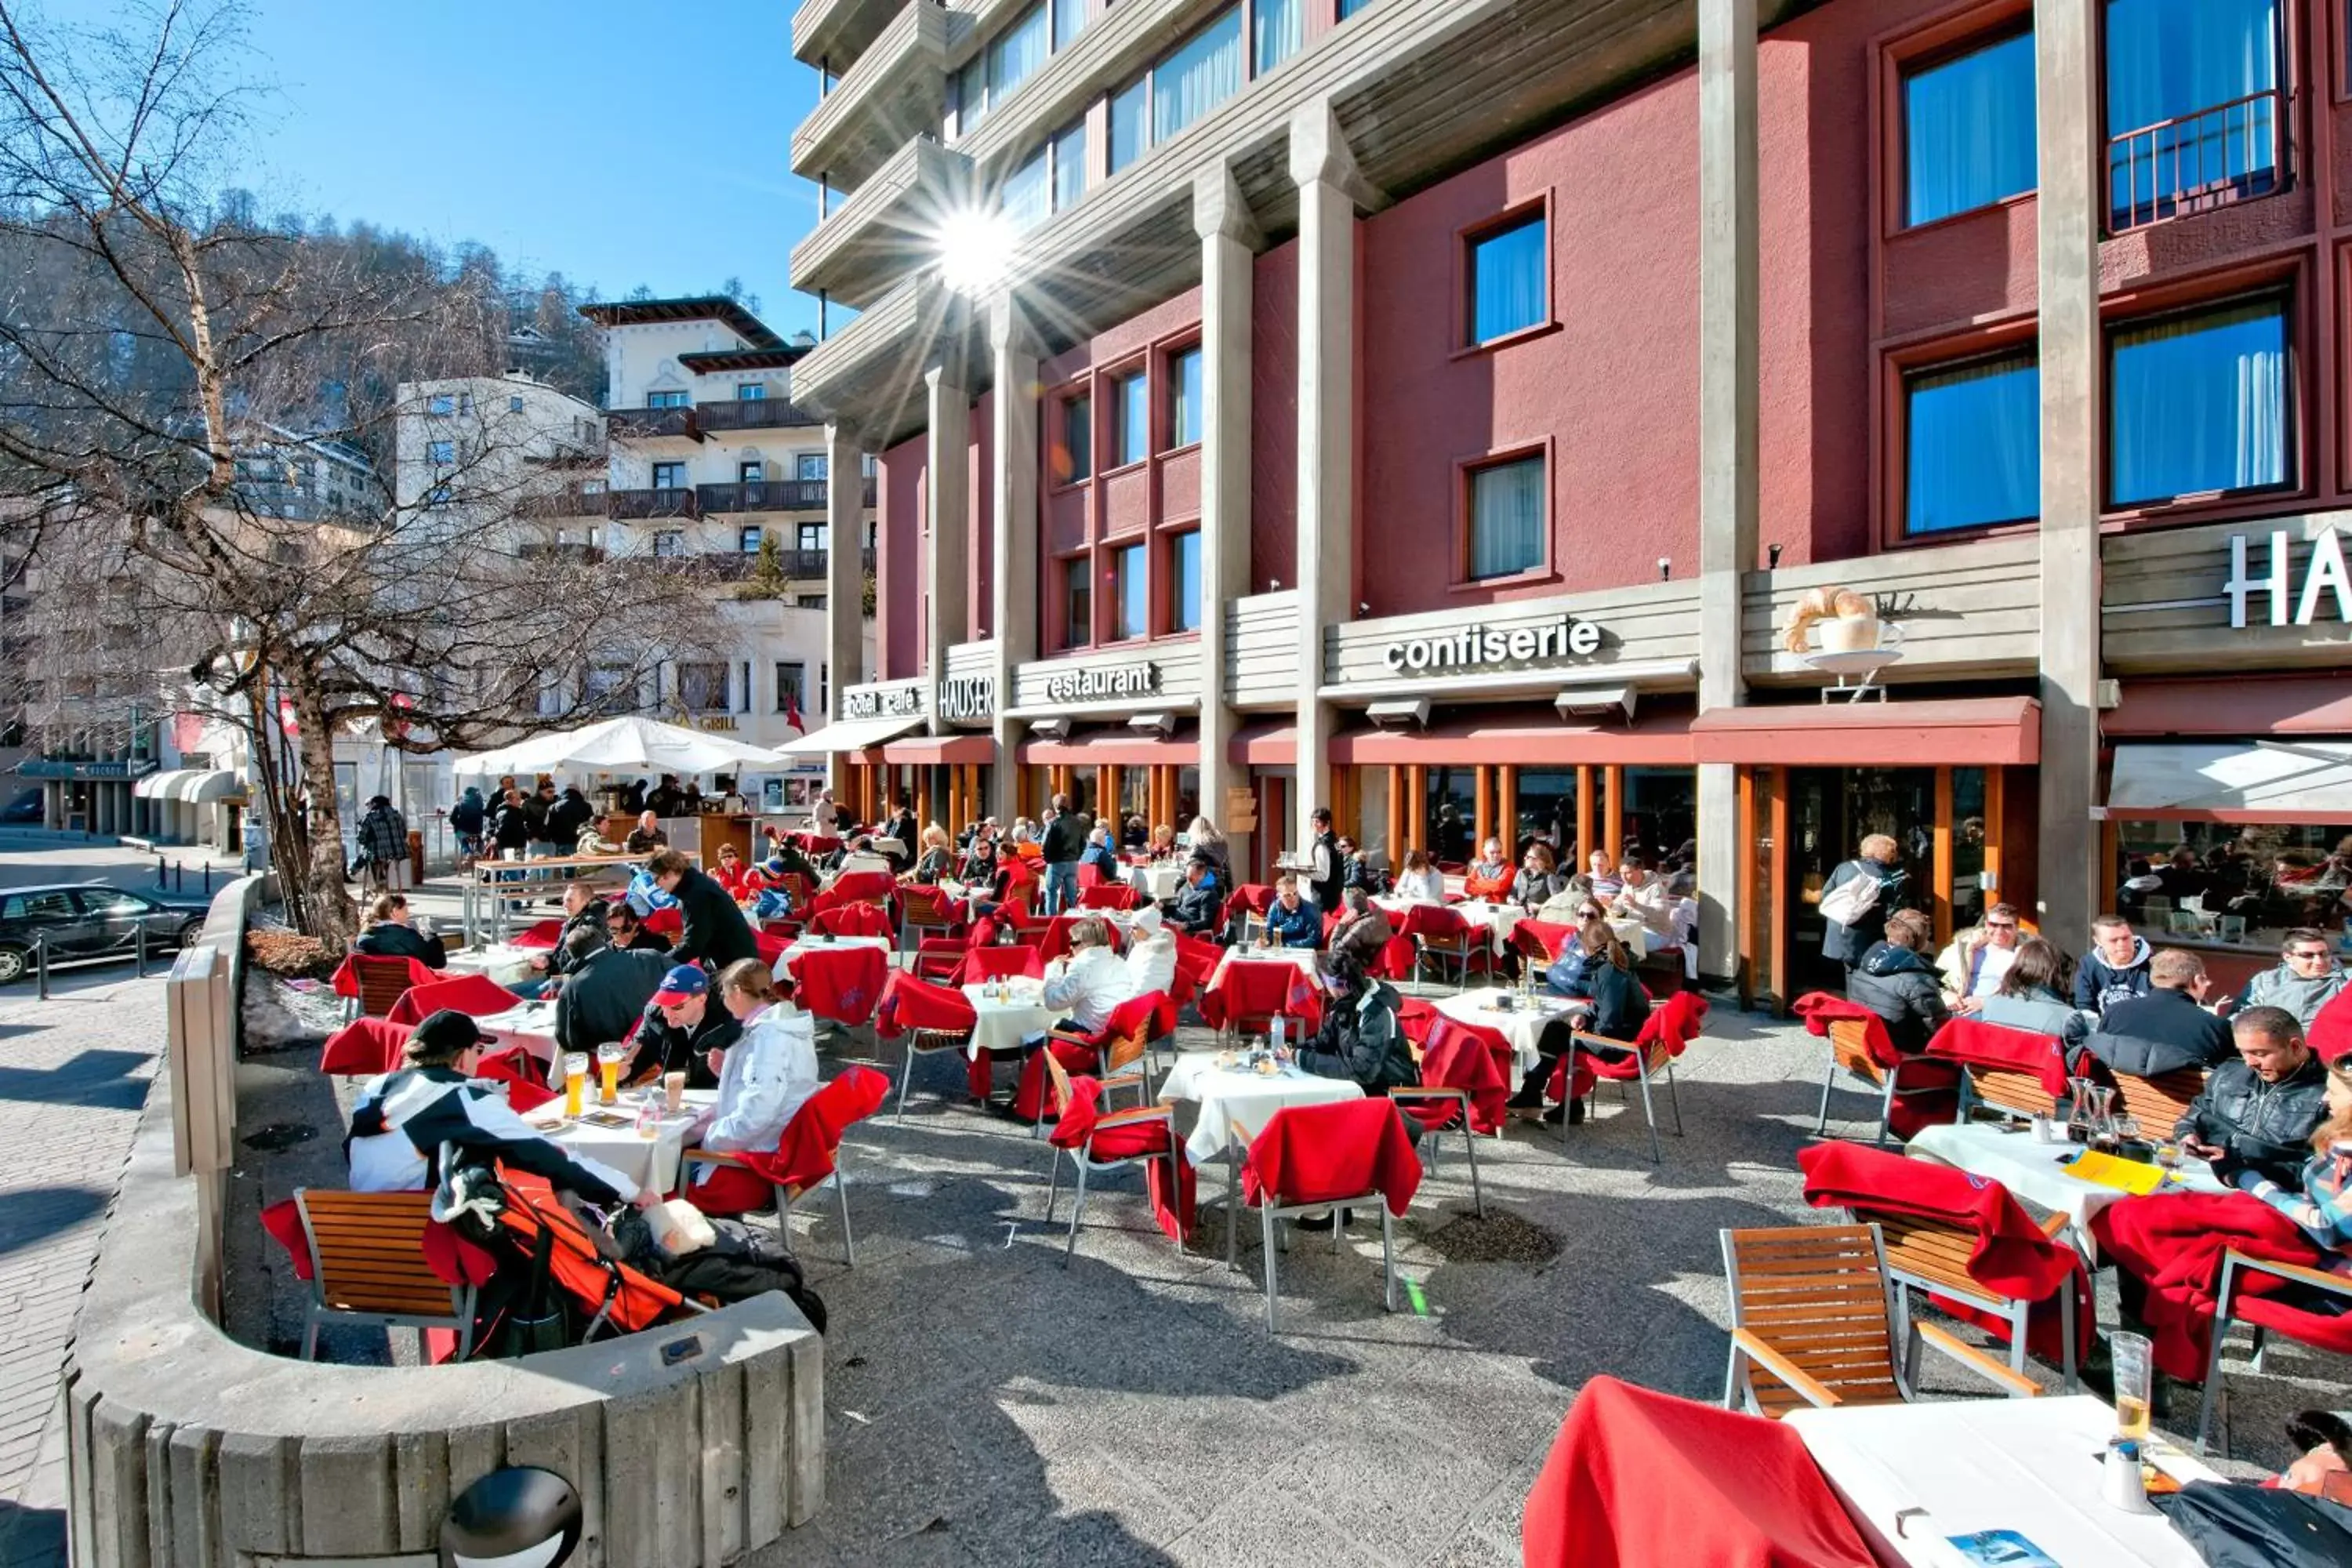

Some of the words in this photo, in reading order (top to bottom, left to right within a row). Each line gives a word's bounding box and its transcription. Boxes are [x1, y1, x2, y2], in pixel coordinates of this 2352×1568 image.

[1382, 614, 1601, 671] confiserie
[939, 677, 994, 717] HAUSER
[1044, 661, 1152, 698] restaurant
[849, 691, 877, 714] hotel
[887, 687, 914, 711] café
[698, 715, 739, 731] GRILL
